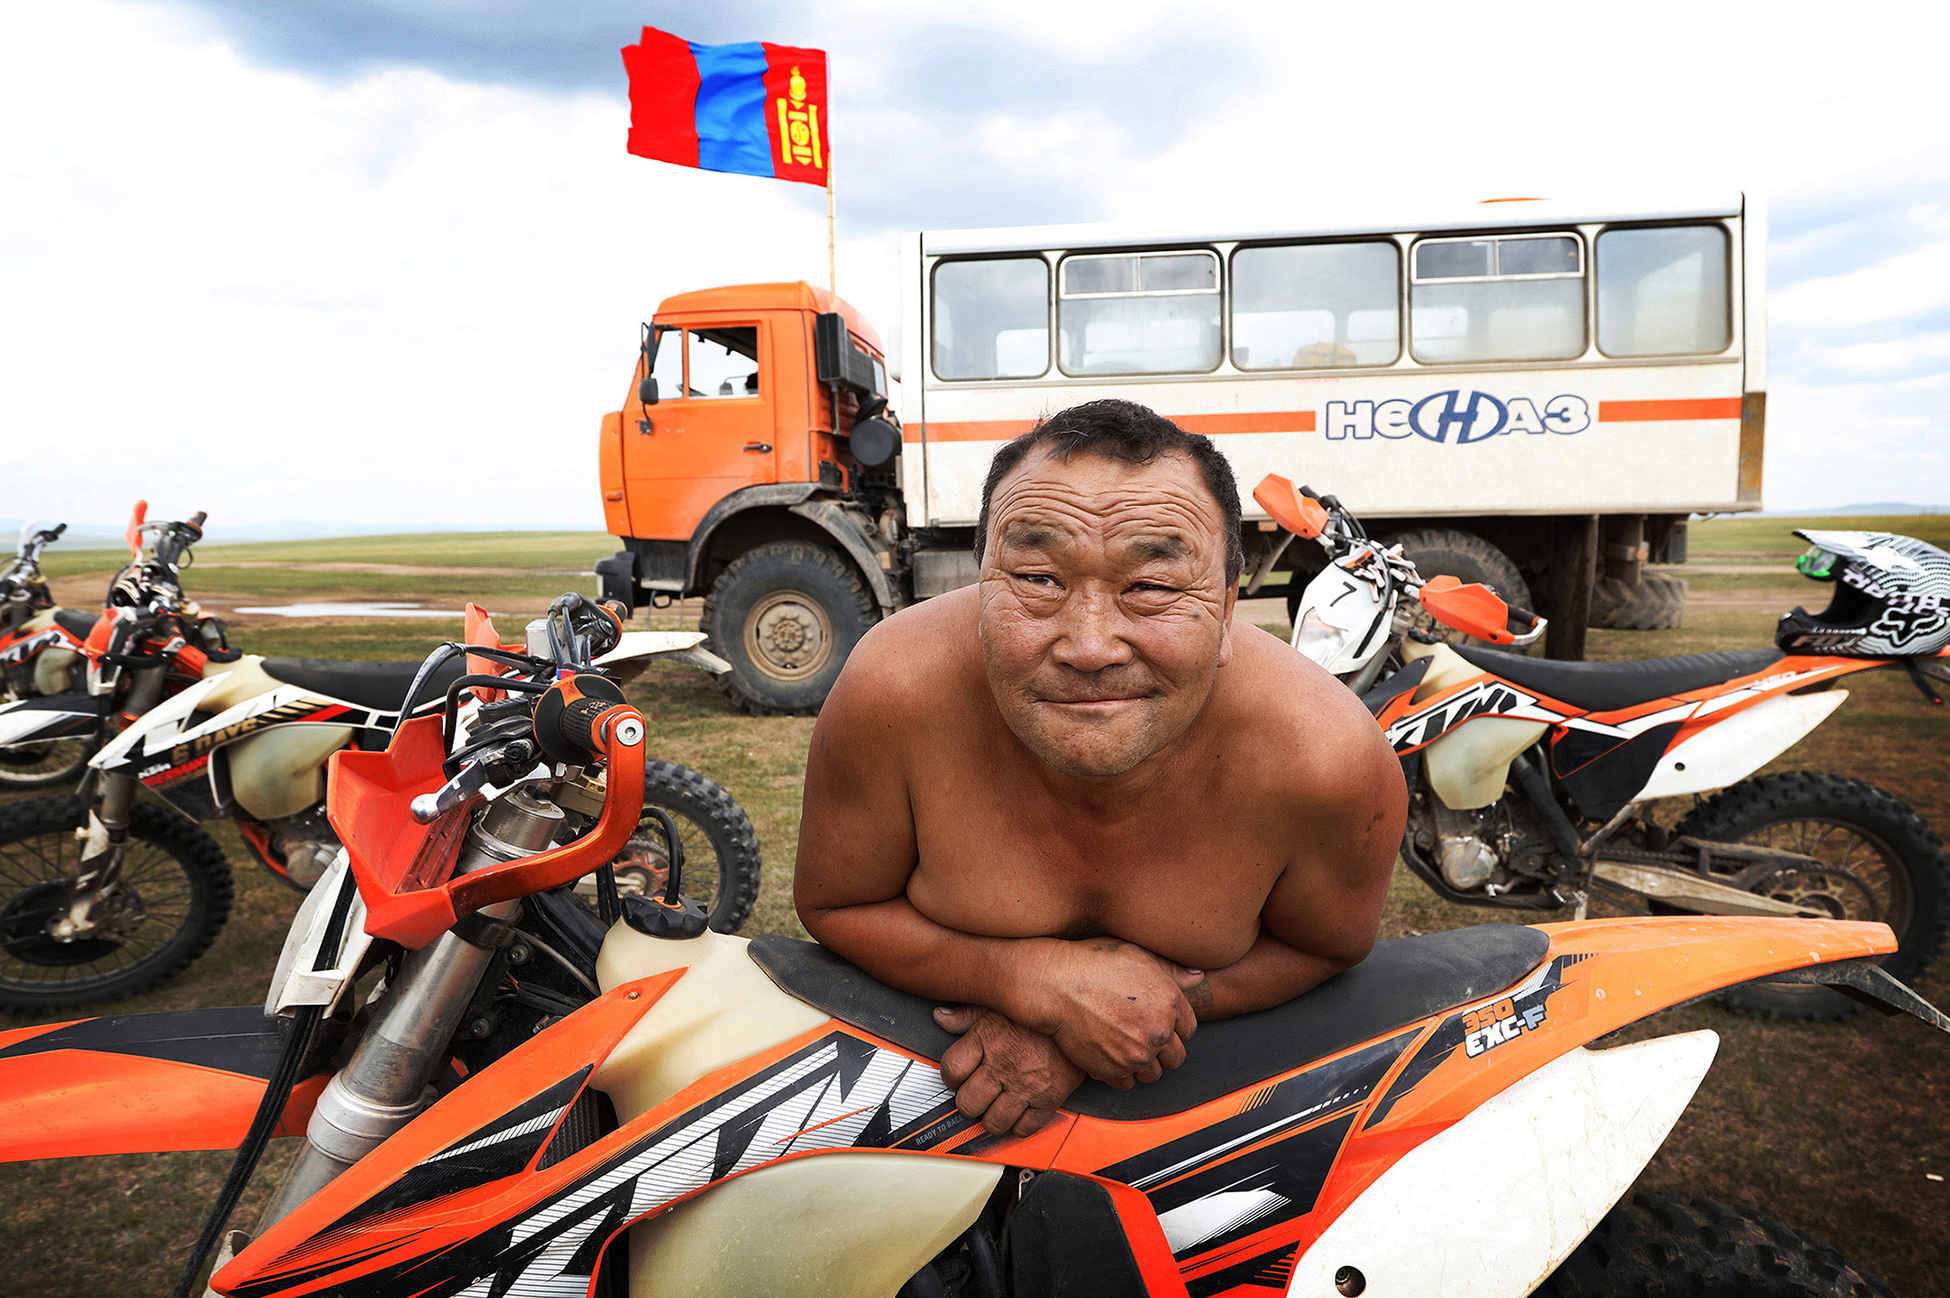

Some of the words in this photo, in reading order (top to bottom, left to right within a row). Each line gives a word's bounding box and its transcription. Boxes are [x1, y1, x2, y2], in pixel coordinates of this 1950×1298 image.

[1330, 581, 1357, 607] 7
[1462, 997, 1515, 1035] 350
[1465, 1004, 1546, 1057] EXC-F
[915, 1128, 937, 1146] READY
[937, 1123, 947, 1133] TO
[946, 1114, 965, 1129] RACE
